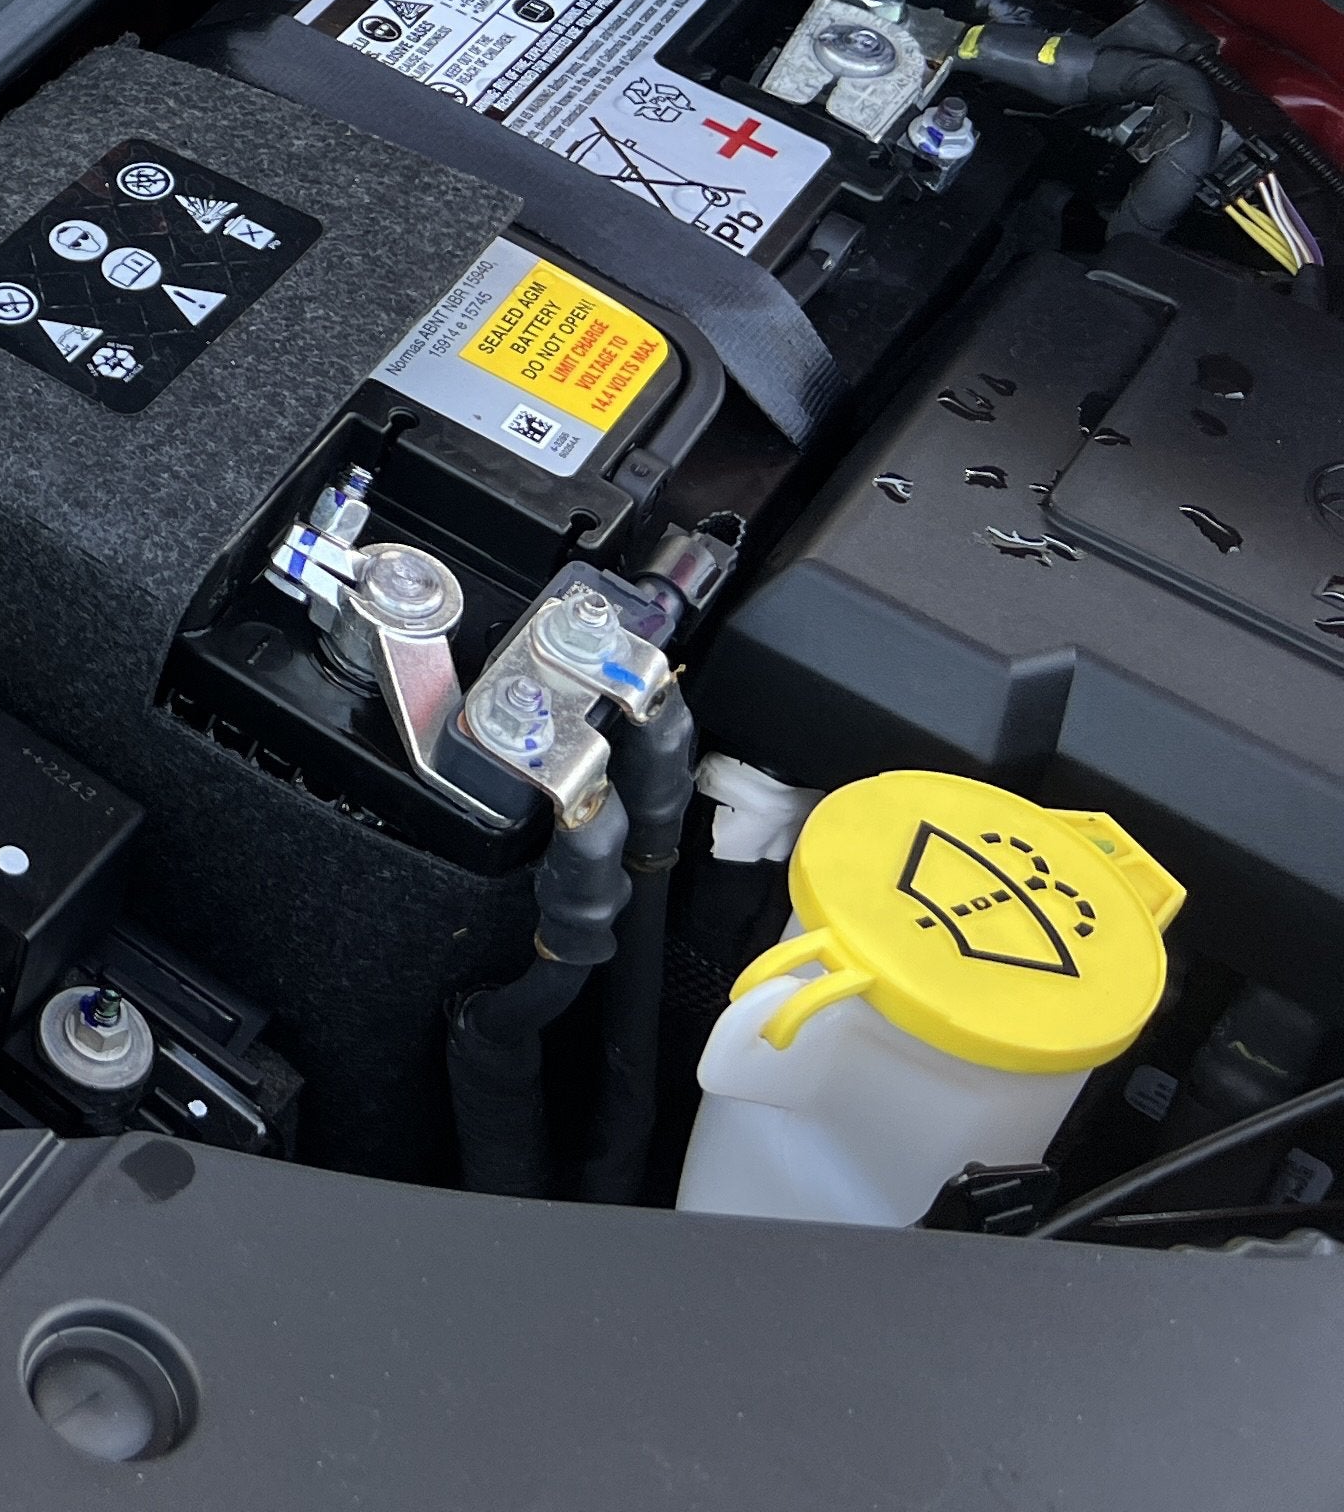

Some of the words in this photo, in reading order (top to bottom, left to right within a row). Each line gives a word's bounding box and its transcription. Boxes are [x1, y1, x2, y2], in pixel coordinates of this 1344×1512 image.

[404, 19, 435, 43] GASES
[415, 25, 452, 56] BLINDNESS
[442, 62, 464, 79] KEEP
[456, 52, 475, 65] OUT
[467, 41, 486, 55] OF
[455, 64, 482, 85] REACH
[712, 208, 764, 250] Pb
[383, 336, 427, 376] Normas
[416, 310, 450, 340] ABNT
[440, 287, 470, 313] NBR
[461, 256, 499, 290] 15940,
[454, 320, 468, 330] e
[459, 290, 494, 321] 15745
[475, 305, 528, 355] SEALED
[515, 280, 547, 309] AGM
[507, 299, 565, 354] BATTERY
[426, 327, 462, 358] 15914
[520, 358, 547, 380] DO
[535, 332, 568, 361] NOT
[555, 297, 597, 335] OPEN!
[546, 353, 582, 383] LIMIT
[567, 318, 610, 357] CHARGE
[573, 347, 621, 391] VOLTAGE
[608, 334, 629, 351] TO
[589, 389, 618, 413] 14.4
[604, 360, 642, 393] VOLTS
[628, 336, 660, 364] MAX.
